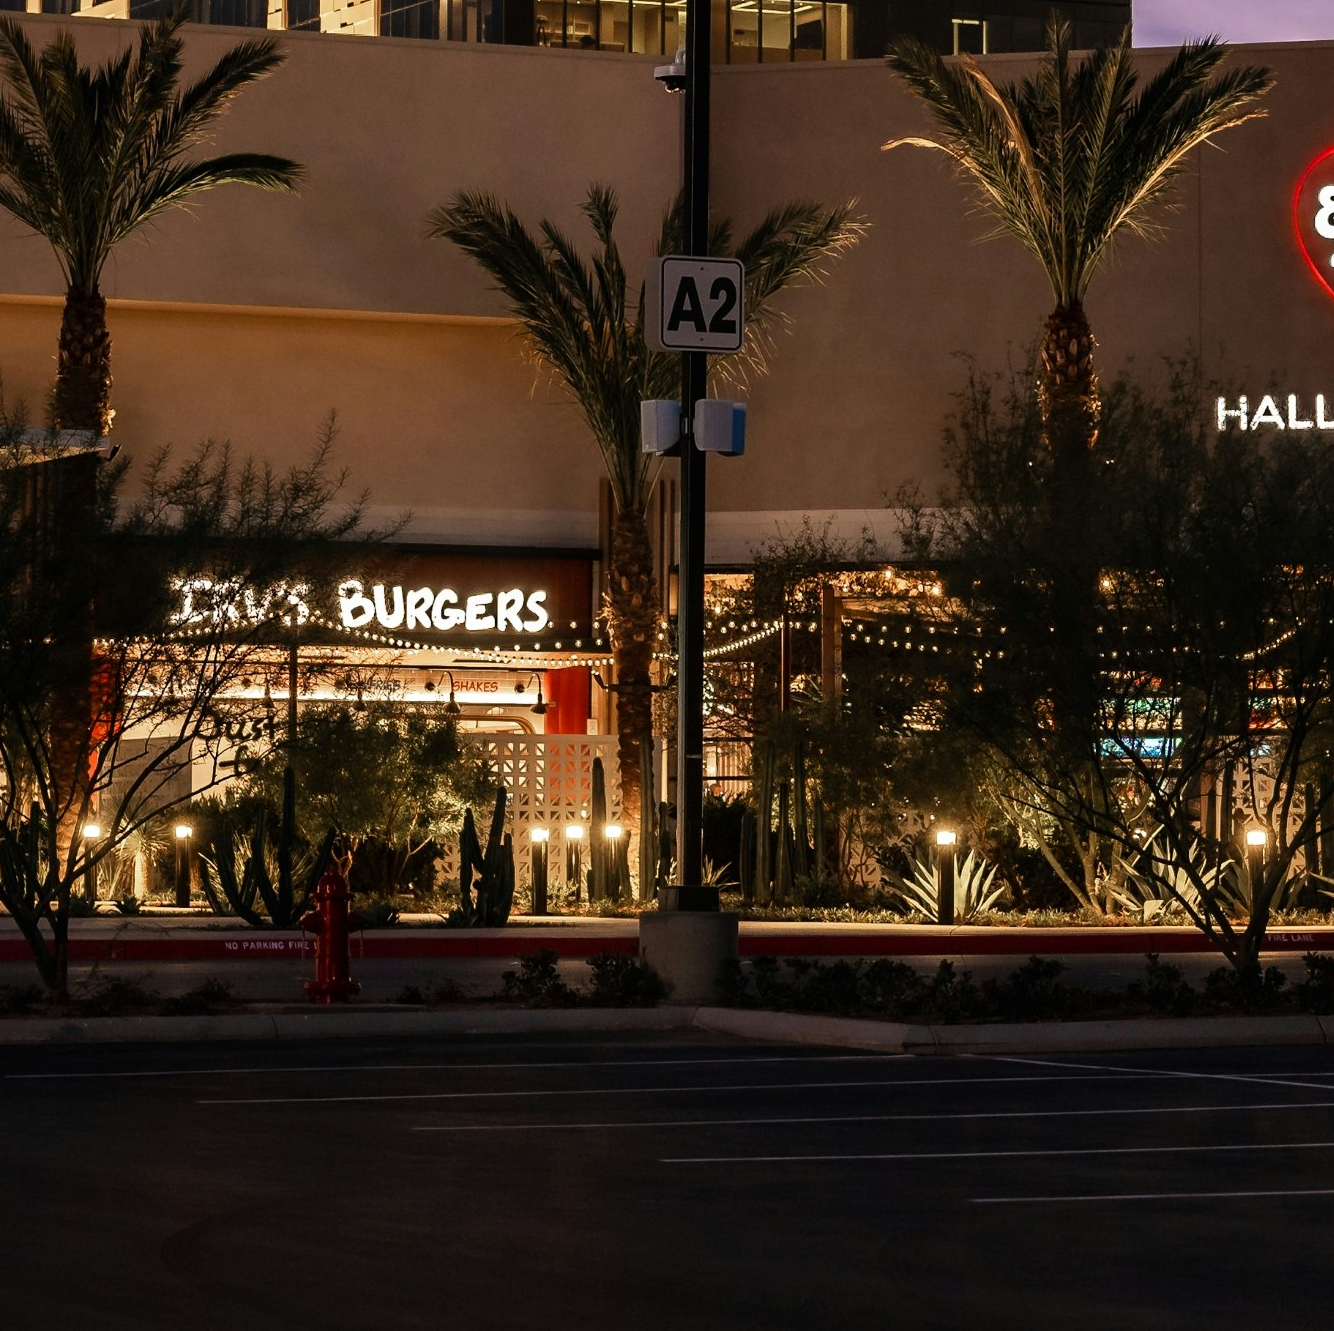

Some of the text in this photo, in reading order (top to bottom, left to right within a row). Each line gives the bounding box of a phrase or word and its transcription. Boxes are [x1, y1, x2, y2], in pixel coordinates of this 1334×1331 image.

[667, 276, 737, 334] A2
[338, 580, 549, 633] BURGERS
[453, 681, 498, 693] SHAKES
[1291, 933, 1315, 942] LANE
[225, 941, 238, 950] NO
[243, 941, 285, 950] PARKING
